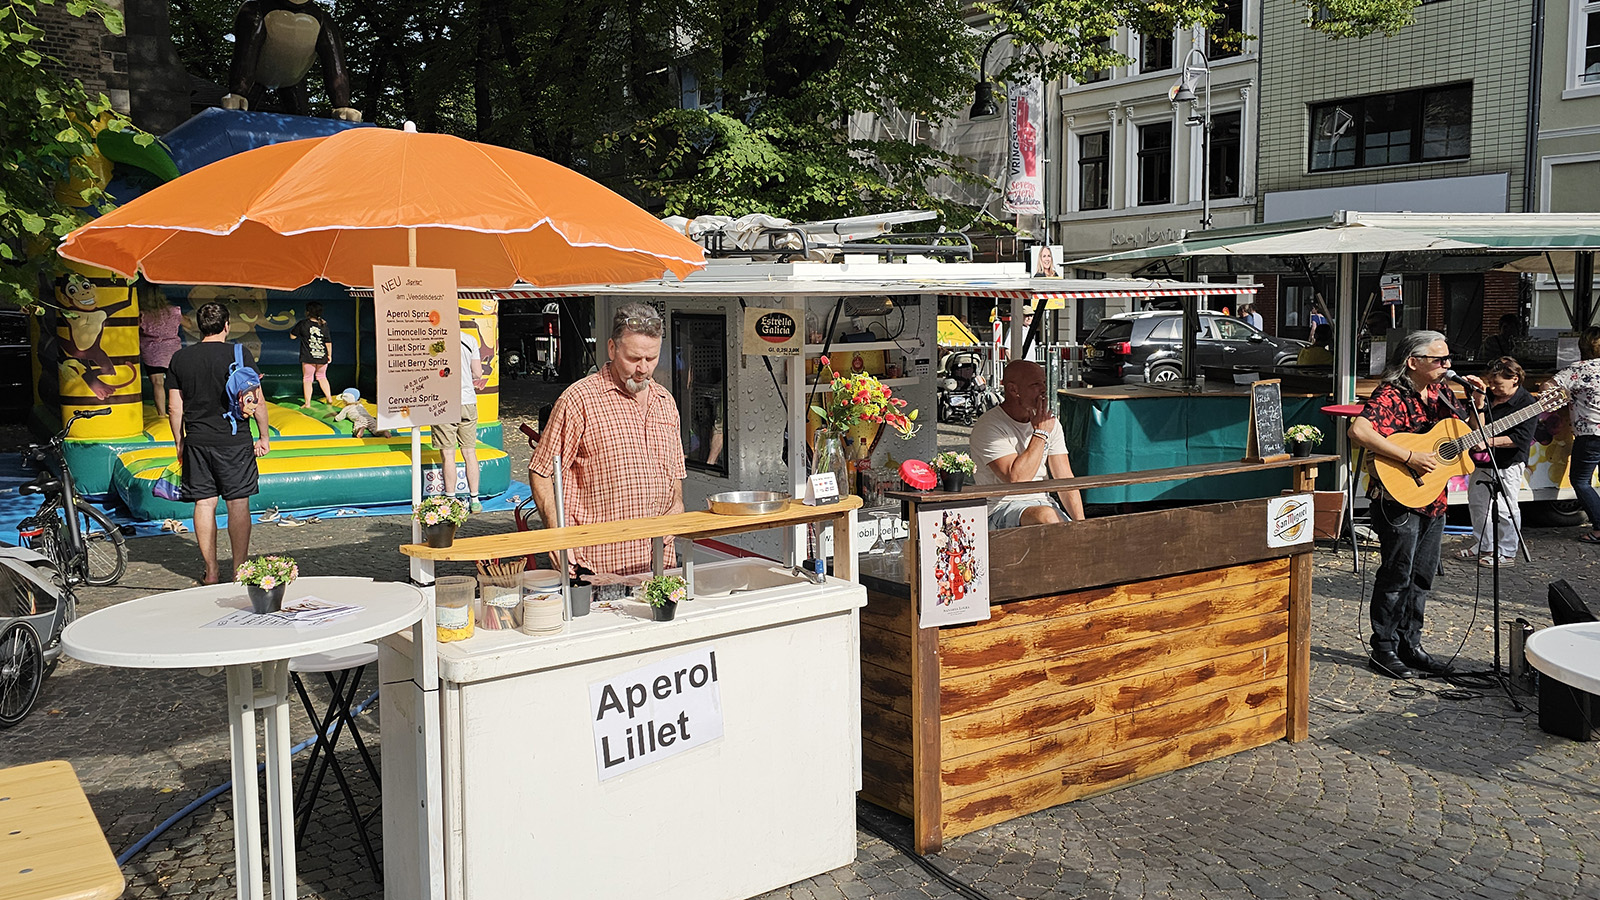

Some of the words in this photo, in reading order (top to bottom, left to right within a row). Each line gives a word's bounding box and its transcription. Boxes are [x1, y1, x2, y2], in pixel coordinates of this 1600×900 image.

[381, 276, 402, 294] NEU
[386, 309, 410, 319] Aperol
[411, 309, 430, 319] Spriz
[761, 316, 792, 326] Estrella
[387, 327, 427, 336] Limoncello
[428, 327, 448, 337] Spritz
[762, 325, 790, 335] Galicia
[388, 343, 406, 352] Lillet
[407, 342, 426, 353] Spriz
[388, 359, 406, 368] Lillet
[407, 359, 427, 369] Berry
[428, 357, 449, 367] Spritz
[418, 393, 439, 404] Spritz
[1274, 519, 1288, 534] San
[1287, 506, 1308, 525] Miguel
[596, 651, 718, 721] Aperol
[601, 710, 691, 769] Lillet
